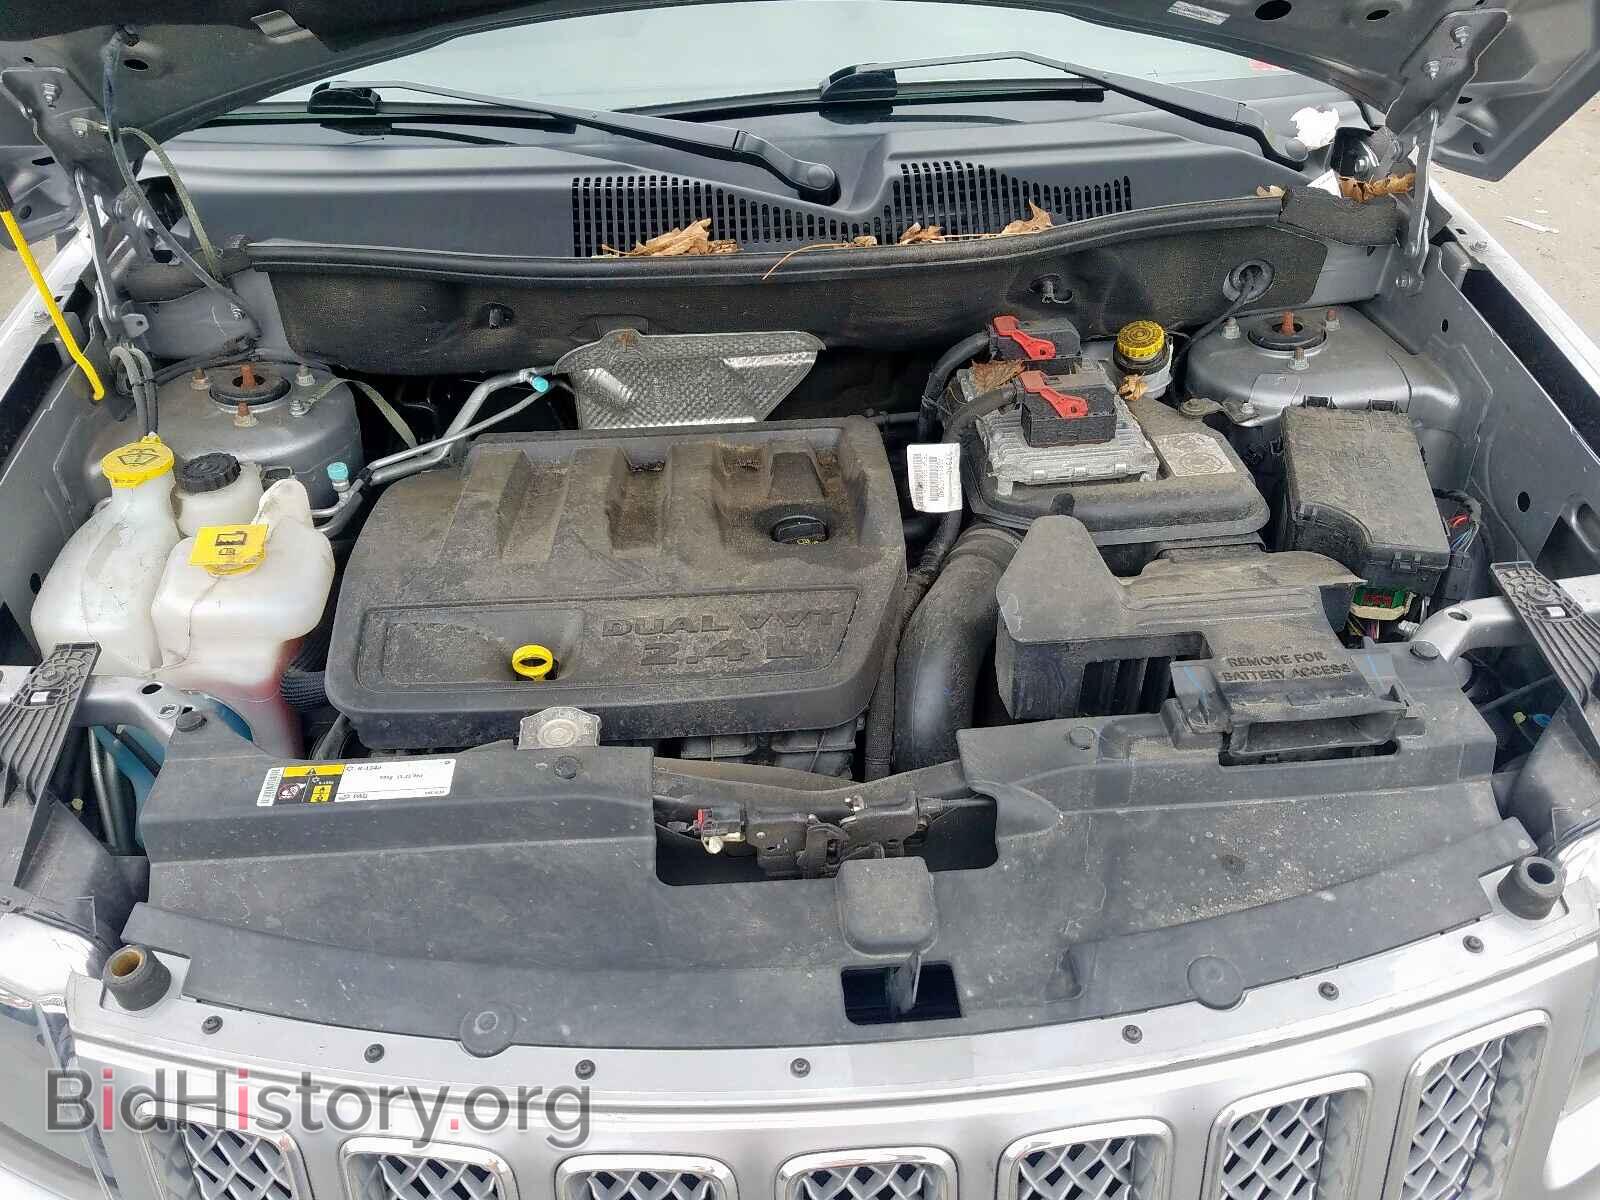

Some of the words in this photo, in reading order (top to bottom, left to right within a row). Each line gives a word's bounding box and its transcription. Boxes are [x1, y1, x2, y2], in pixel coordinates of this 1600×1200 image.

[602, 615, 730, 637] DUAL
[739, 609, 846, 630] VVT
[1228, 656, 1291, 668] REMOVE
[1294, 651, 1327, 664] FOR
[1221, 668, 1286, 682] BATTERY
[1291, 664, 1352, 678] ACCESS
